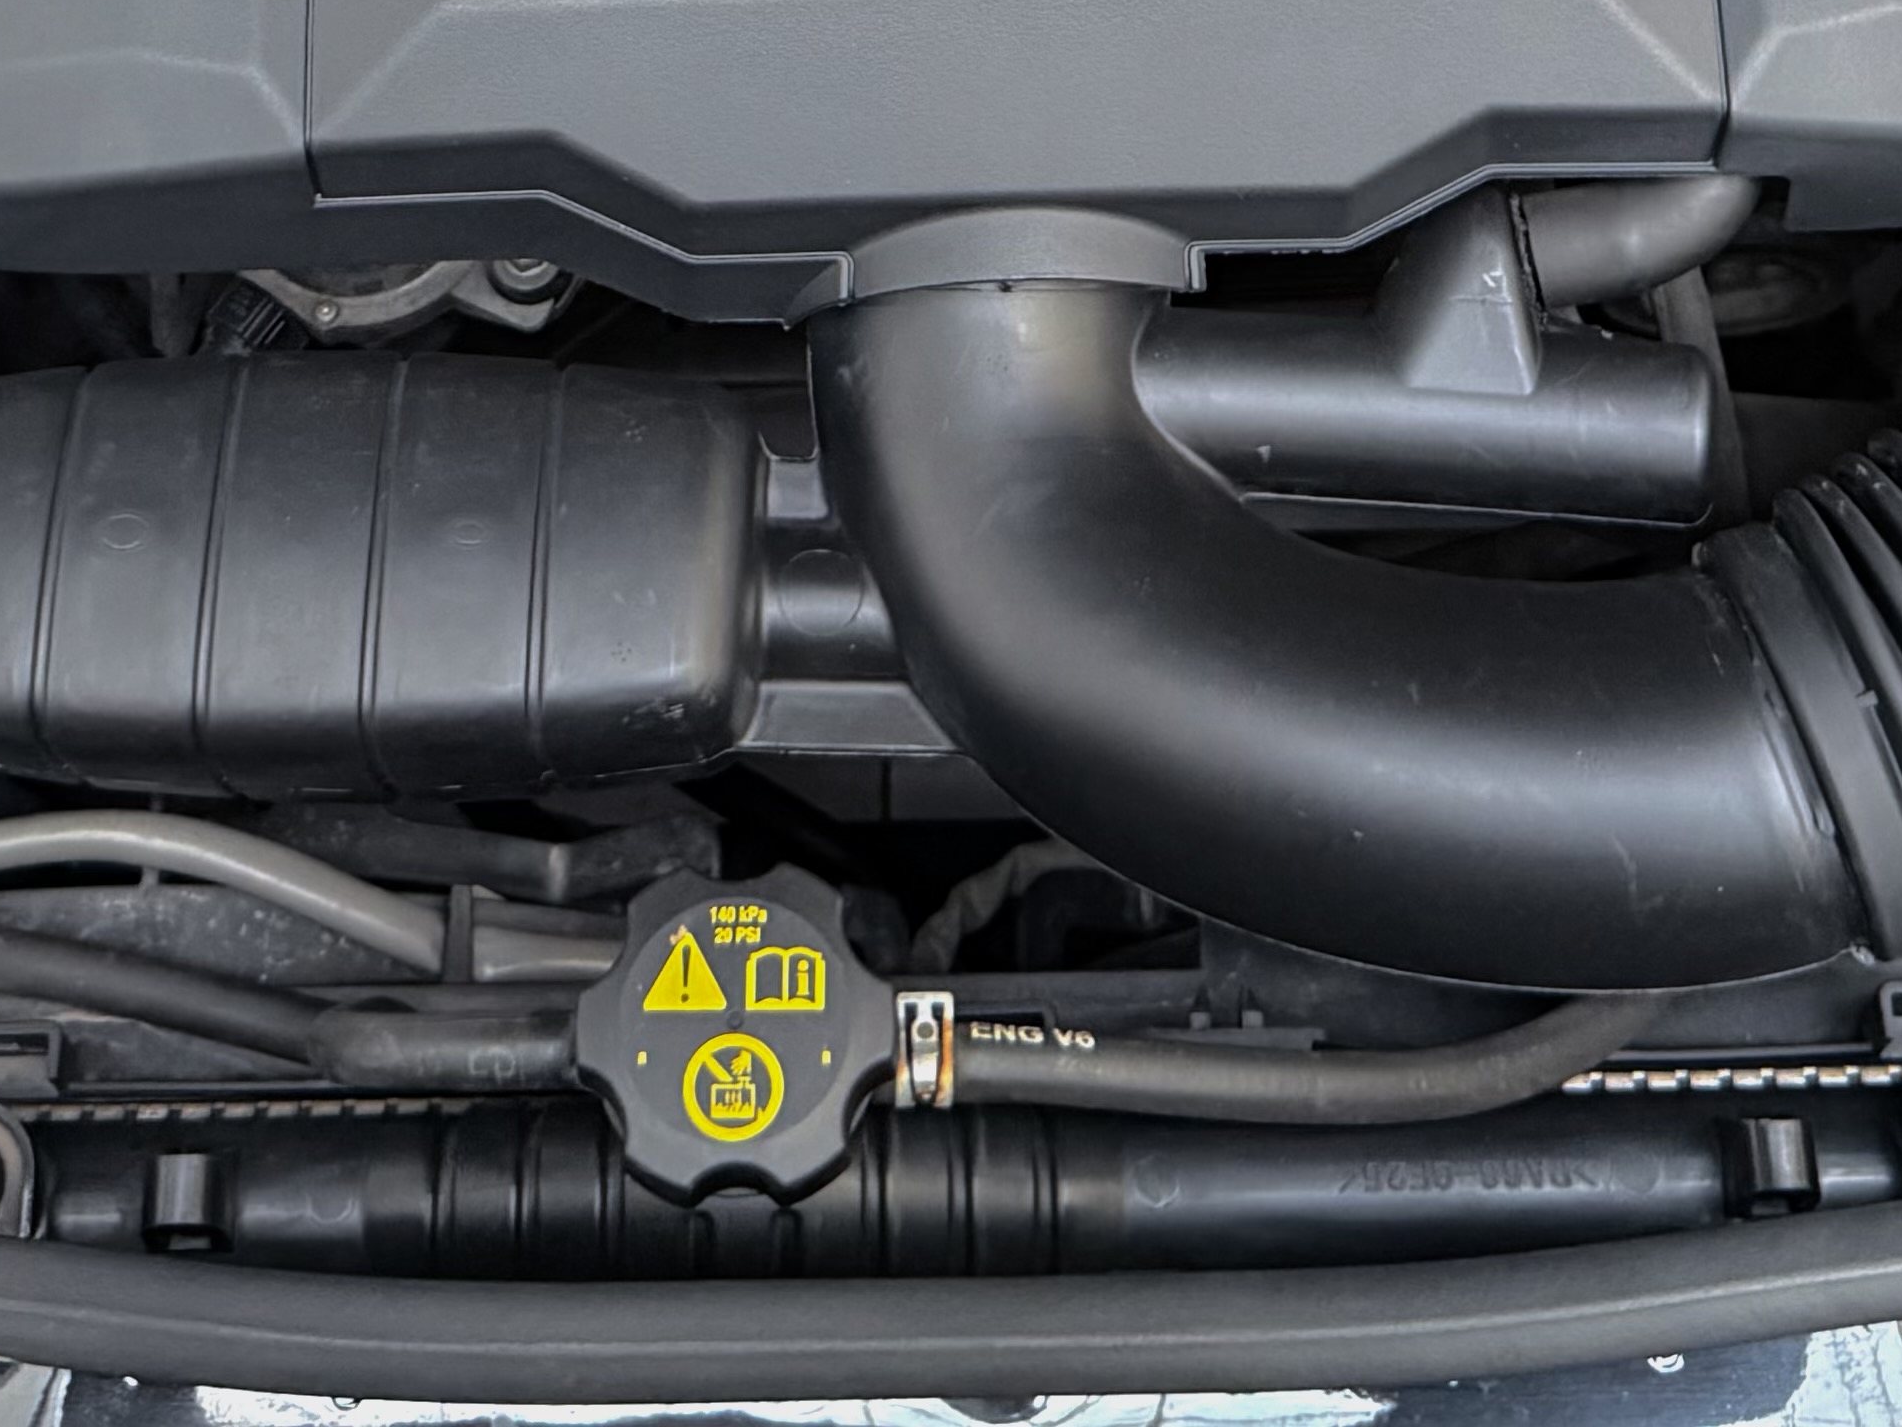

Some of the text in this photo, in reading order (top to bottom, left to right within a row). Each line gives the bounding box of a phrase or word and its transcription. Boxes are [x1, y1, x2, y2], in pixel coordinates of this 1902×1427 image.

[709, 905, 768, 924] 140 kPa
[714, 926, 762, 945] 20 PSI
[970, 1020, 1096, 1049] ENG V6
